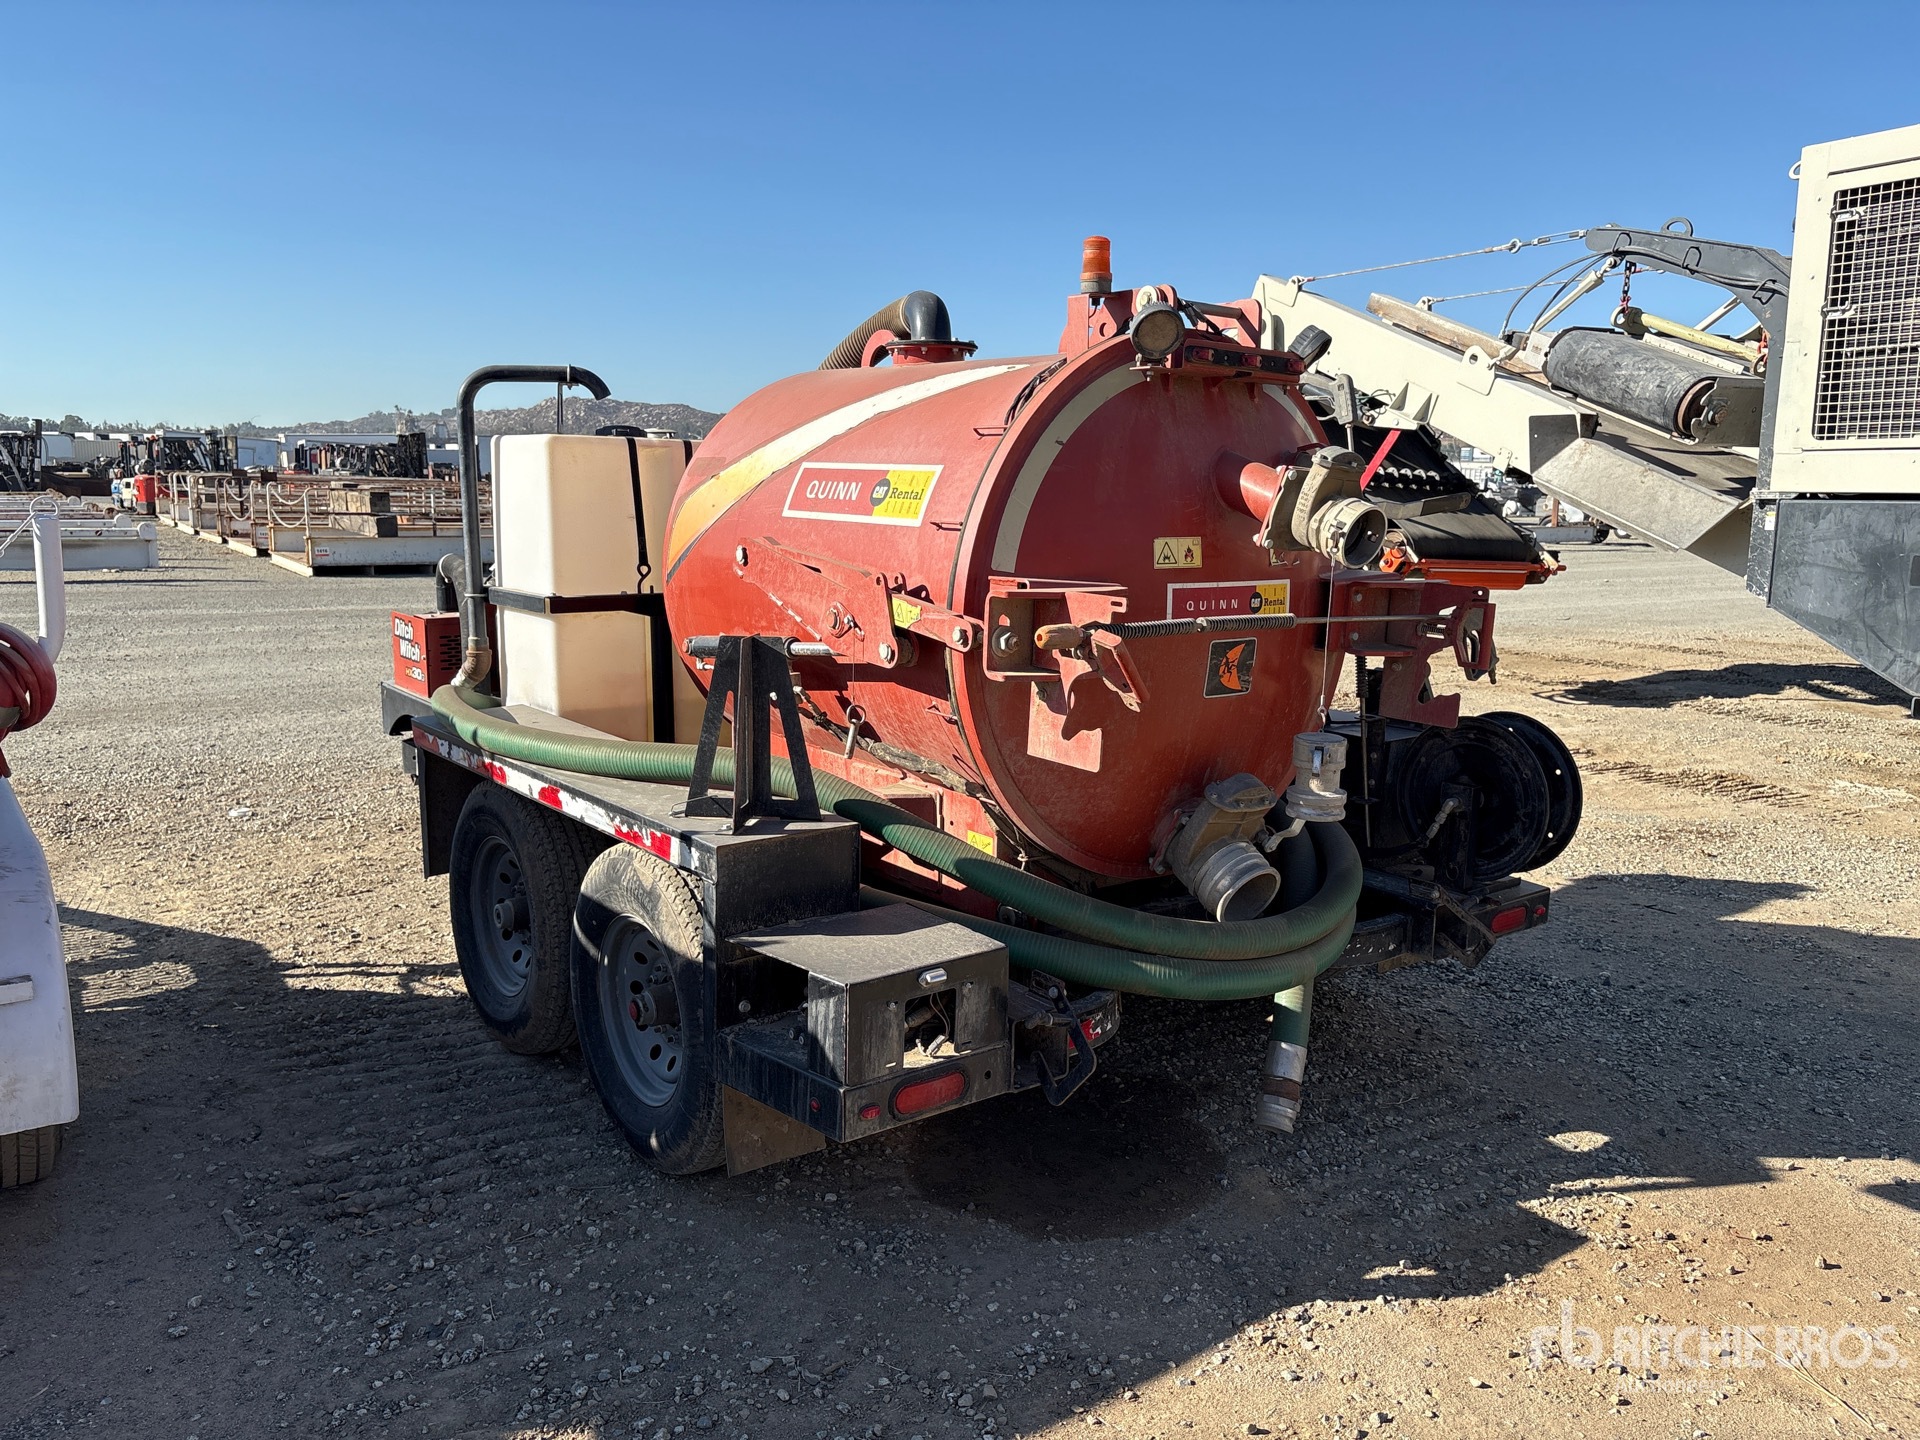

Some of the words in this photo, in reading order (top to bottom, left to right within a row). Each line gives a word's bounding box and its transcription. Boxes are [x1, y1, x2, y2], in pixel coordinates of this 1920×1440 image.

[806, 480, 862, 501] QUINN
[872, 486, 888, 499] CAT
[889, 487, 924, 500] Rental
[1186, 599, 1238, 611] QUINN
[1251, 598, 1261, 608] CAT
[1263, 597, 1285, 607] Rental
[394, 617, 413, 640] Ditch
[400, 638, 420, 663] Witch
